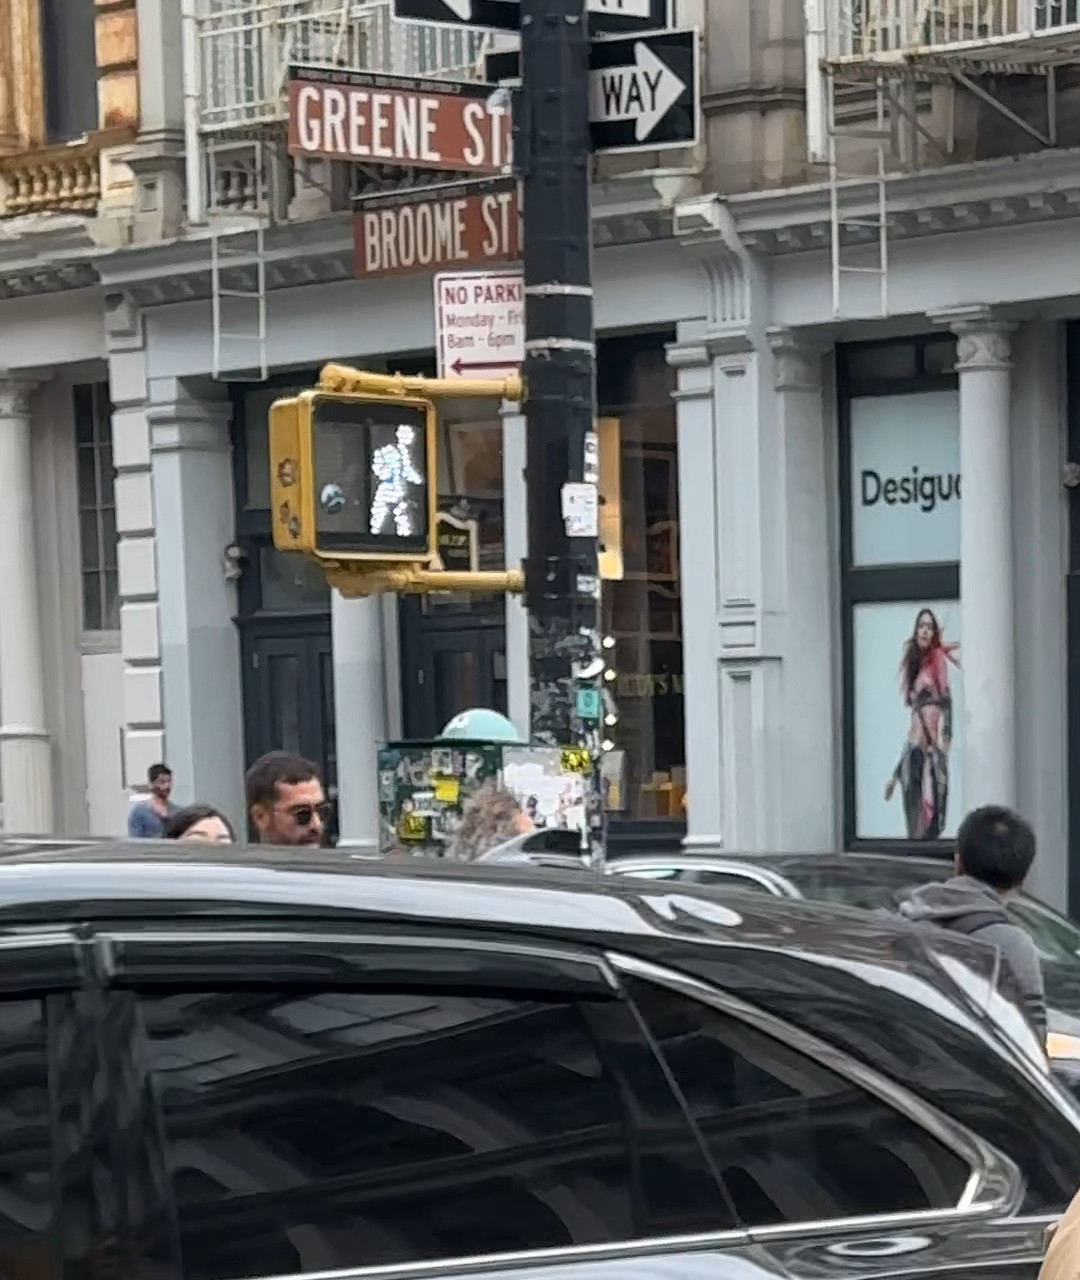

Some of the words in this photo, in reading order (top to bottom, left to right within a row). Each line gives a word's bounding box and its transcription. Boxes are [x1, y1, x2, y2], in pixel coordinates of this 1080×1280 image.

[601, 68, 663, 116] WAY
[296, 86, 441, 162] GREENE
[462, 102, 505, 167] ST
[363, 200, 470, 273] BROOME
[481, 191, 512, 256] ST
[445, 286, 468, 305] NO
[446, 313, 496, 329] Monday
[447, 333, 475, 349] 8am
[487, 332, 515, 350] 6pm
